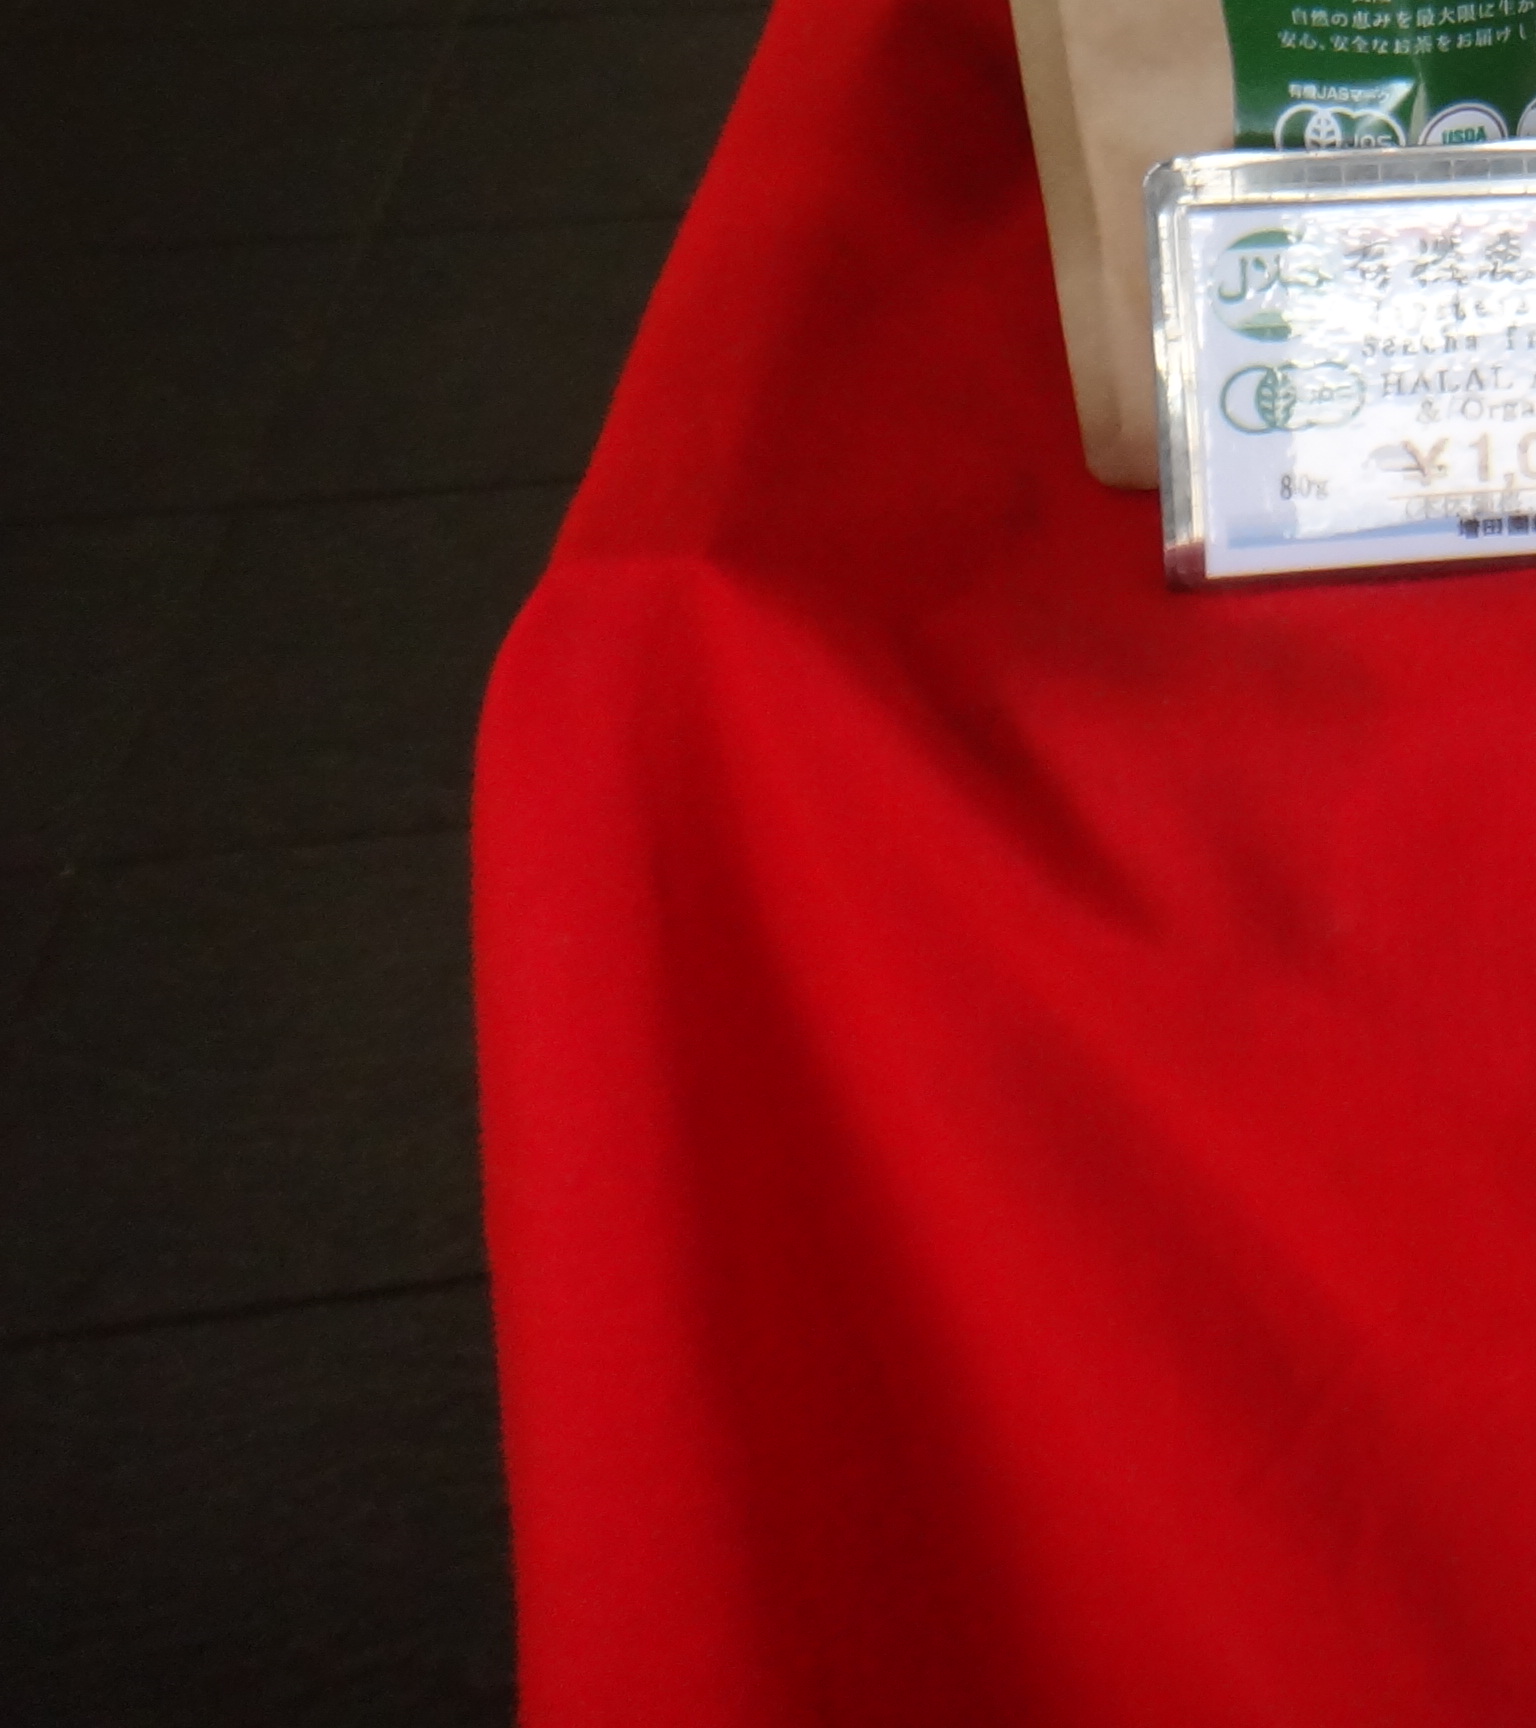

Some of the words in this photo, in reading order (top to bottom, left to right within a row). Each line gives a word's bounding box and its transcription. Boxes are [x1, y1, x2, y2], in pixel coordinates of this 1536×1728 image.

[1441, 126, 1488, 144] USDA
[1382, 367, 1514, 397] HALAL
[1416, 400, 1441, 423] &
